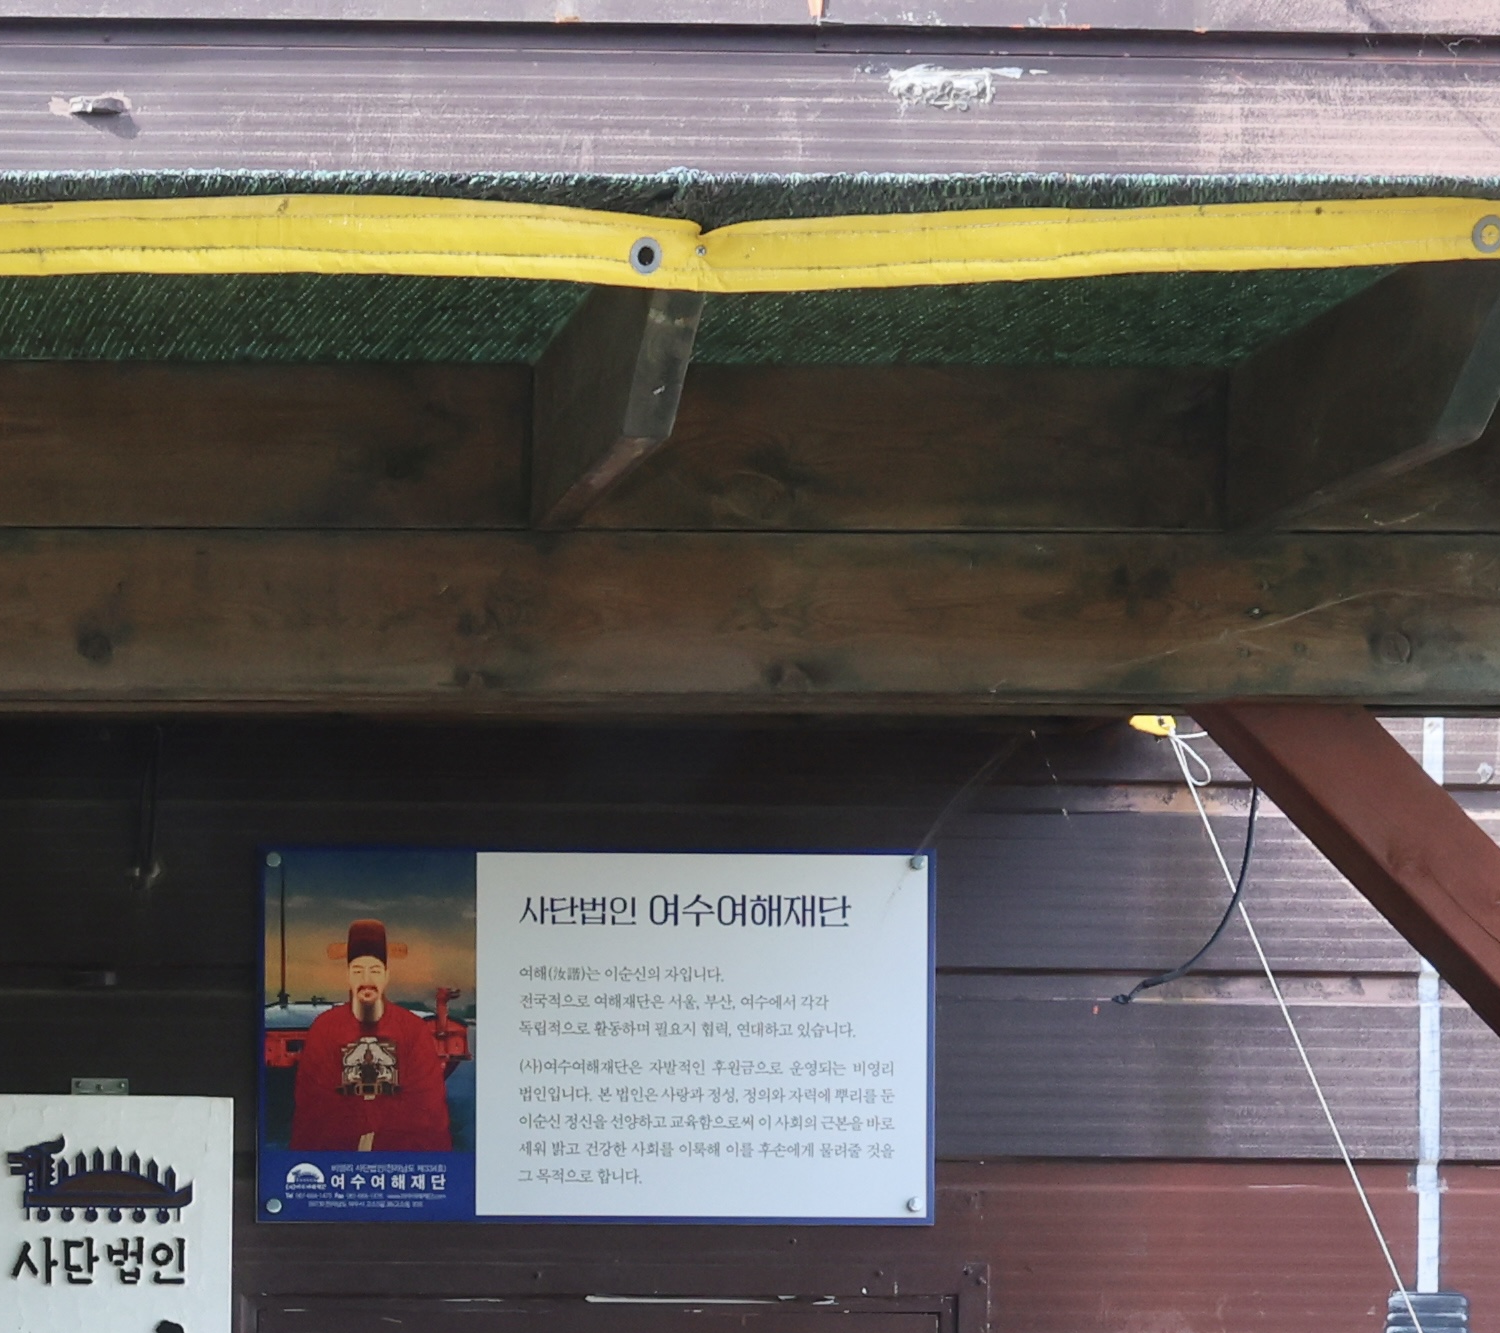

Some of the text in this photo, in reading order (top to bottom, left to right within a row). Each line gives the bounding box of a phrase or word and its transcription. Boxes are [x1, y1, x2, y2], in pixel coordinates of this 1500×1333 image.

[518, 894, 852, 927] 사단법인 여수여해재단
[604, 965, 660, 982] 이순신의
[665, 966, 724, 982] 자입니다.
[519, 993, 829, 1010] 전국적으로 여해재단은 서울, 부산, 여수에서 각각
[519, 1020, 856, 1038] 독립적으로 활동하며 필요시 협력, 연대하고 있습니다.
[519, 1059, 894, 1077] (사)여수여해재단은 자발적인 후원금으로 운영되는 비영리
[519, 1086, 895, 1104] 법인입니다. 본 법인은 사랑과 정성, 정의와 자력에 뿌리를 둔
[519, 1113, 895, 1131] 이순신 정신을 선양하고 교육함으로써 이 사회의 근본을 바로
[519, 1141, 895, 1159] 세워 밝고 건강한 사회를 이룩해 이를 후손에게 물려줄 것을
[330, 1173, 446, 1190] 여수여해재단
[518, 1168, 642, 1184] 그 목적으로 합니다.
[10, 1236, 188, 1286] 사단법인
